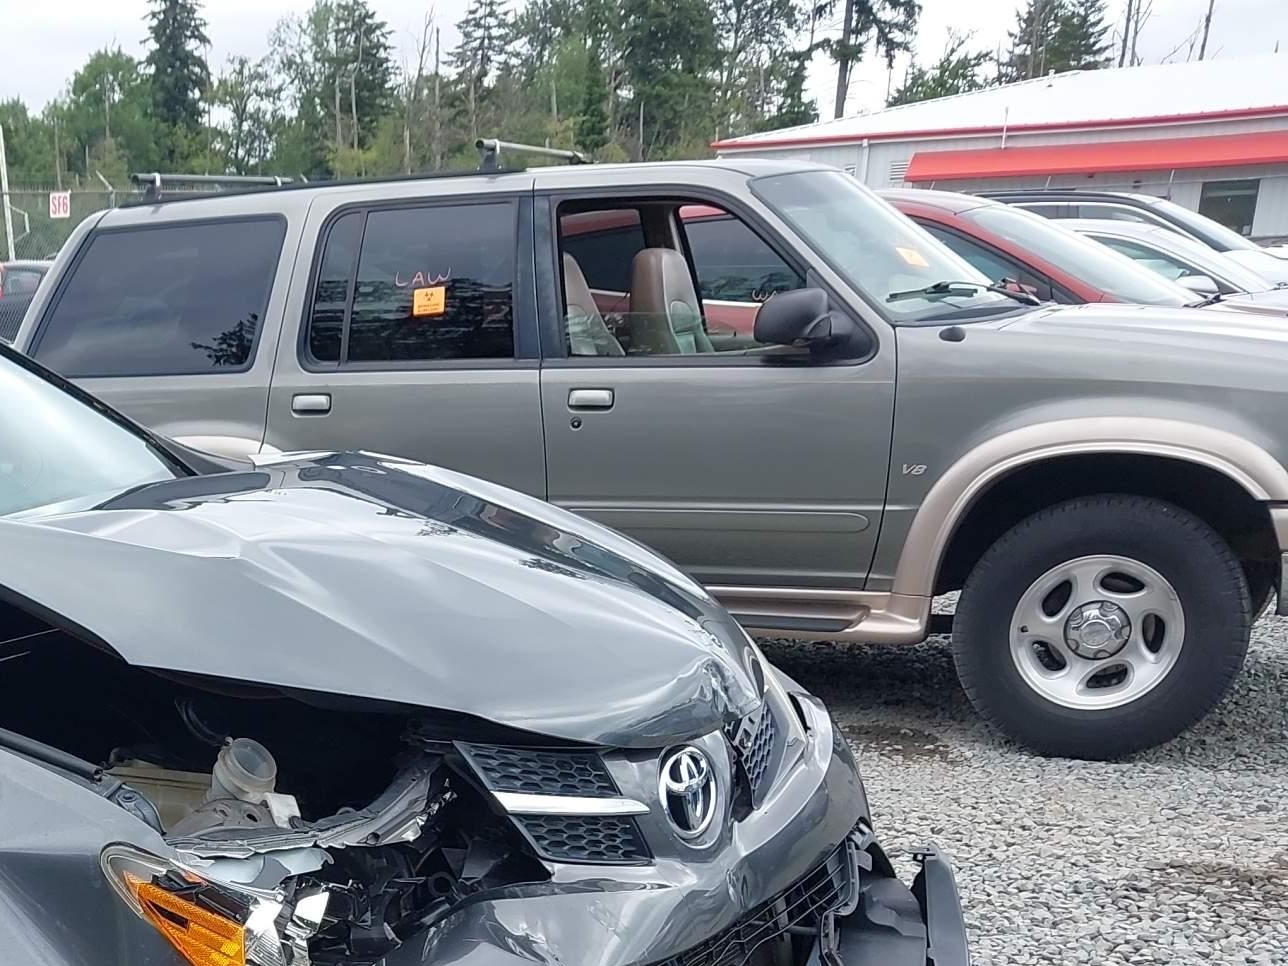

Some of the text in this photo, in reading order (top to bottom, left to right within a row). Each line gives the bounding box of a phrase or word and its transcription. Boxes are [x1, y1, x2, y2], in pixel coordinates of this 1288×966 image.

[51, 195, 69, 215] SF6
[395, 267, 452, 287] LAW
[902, 463, 928, 475] V8
